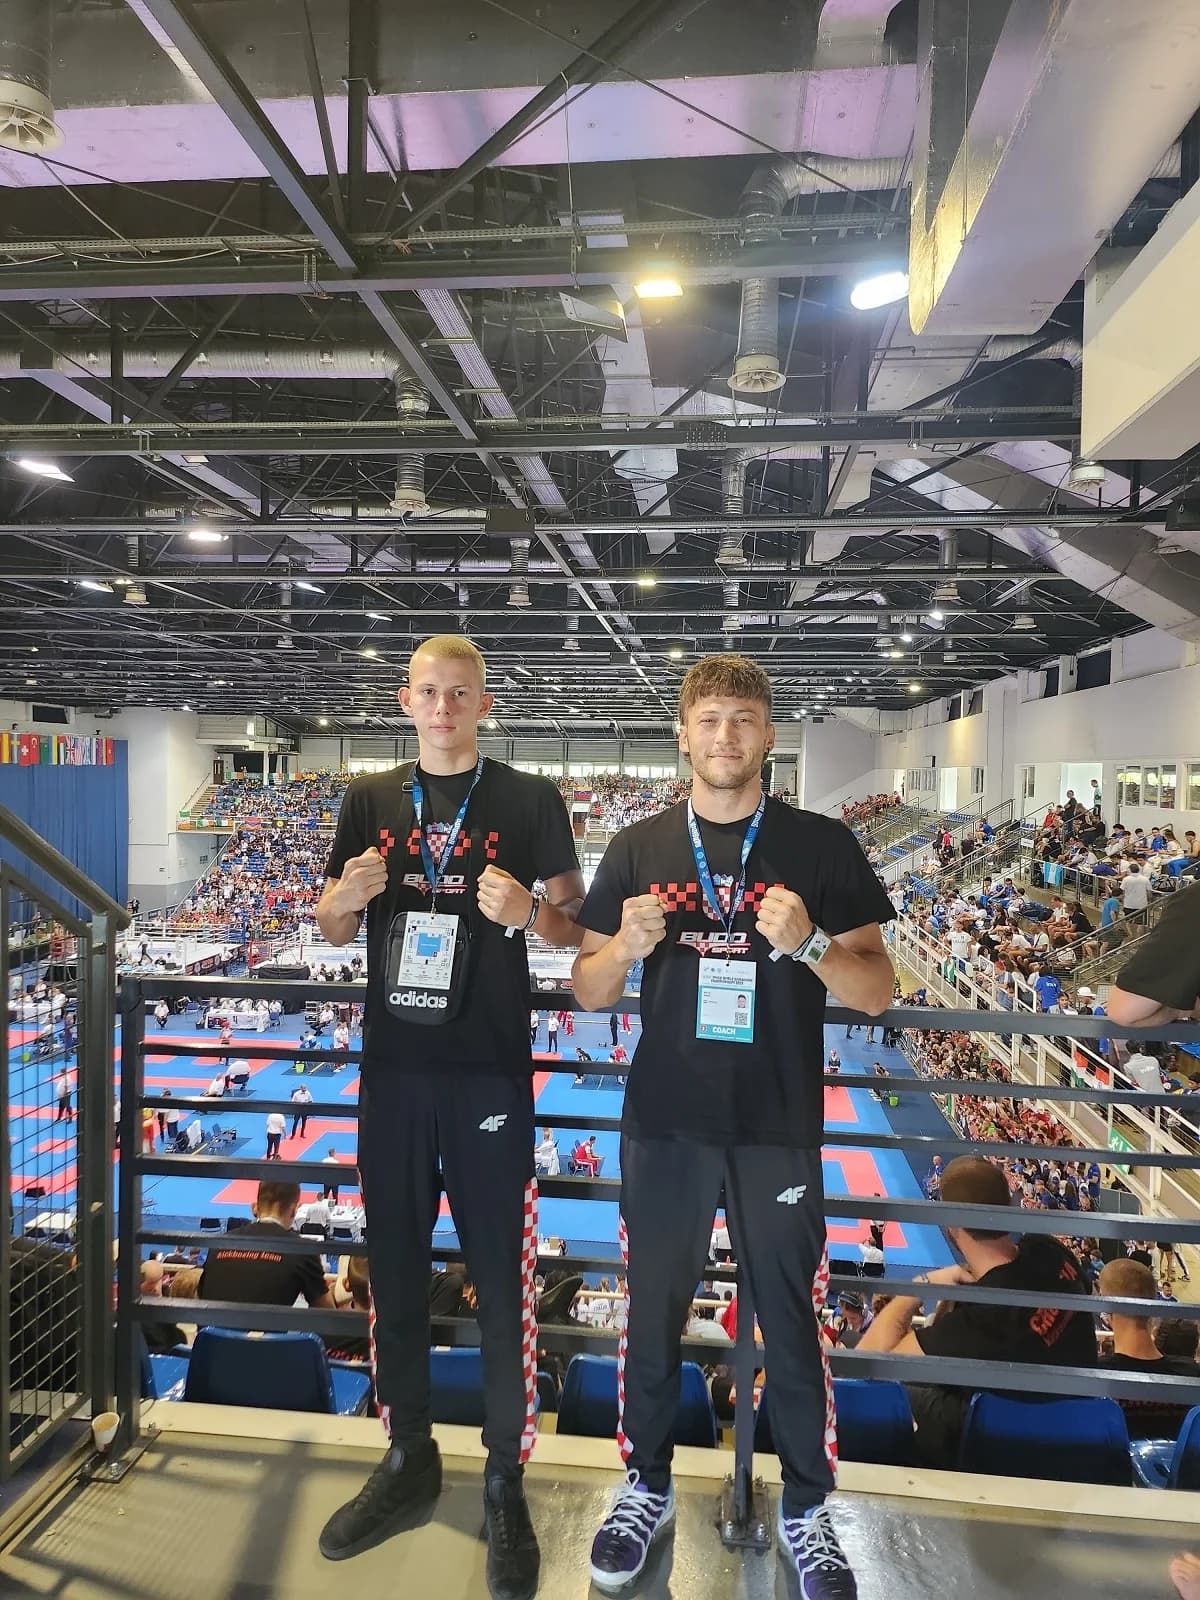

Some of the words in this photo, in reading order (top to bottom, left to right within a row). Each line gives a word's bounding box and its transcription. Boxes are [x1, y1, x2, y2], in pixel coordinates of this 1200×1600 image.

[680, 931, 748, 943] BUDO
[389, 991, 448, 1009] adidas
[712, 1026, 736, 1036] COACH
[479, 1114, 508, 1132] 4F
[776, 1184, 807, 1205] 4F
